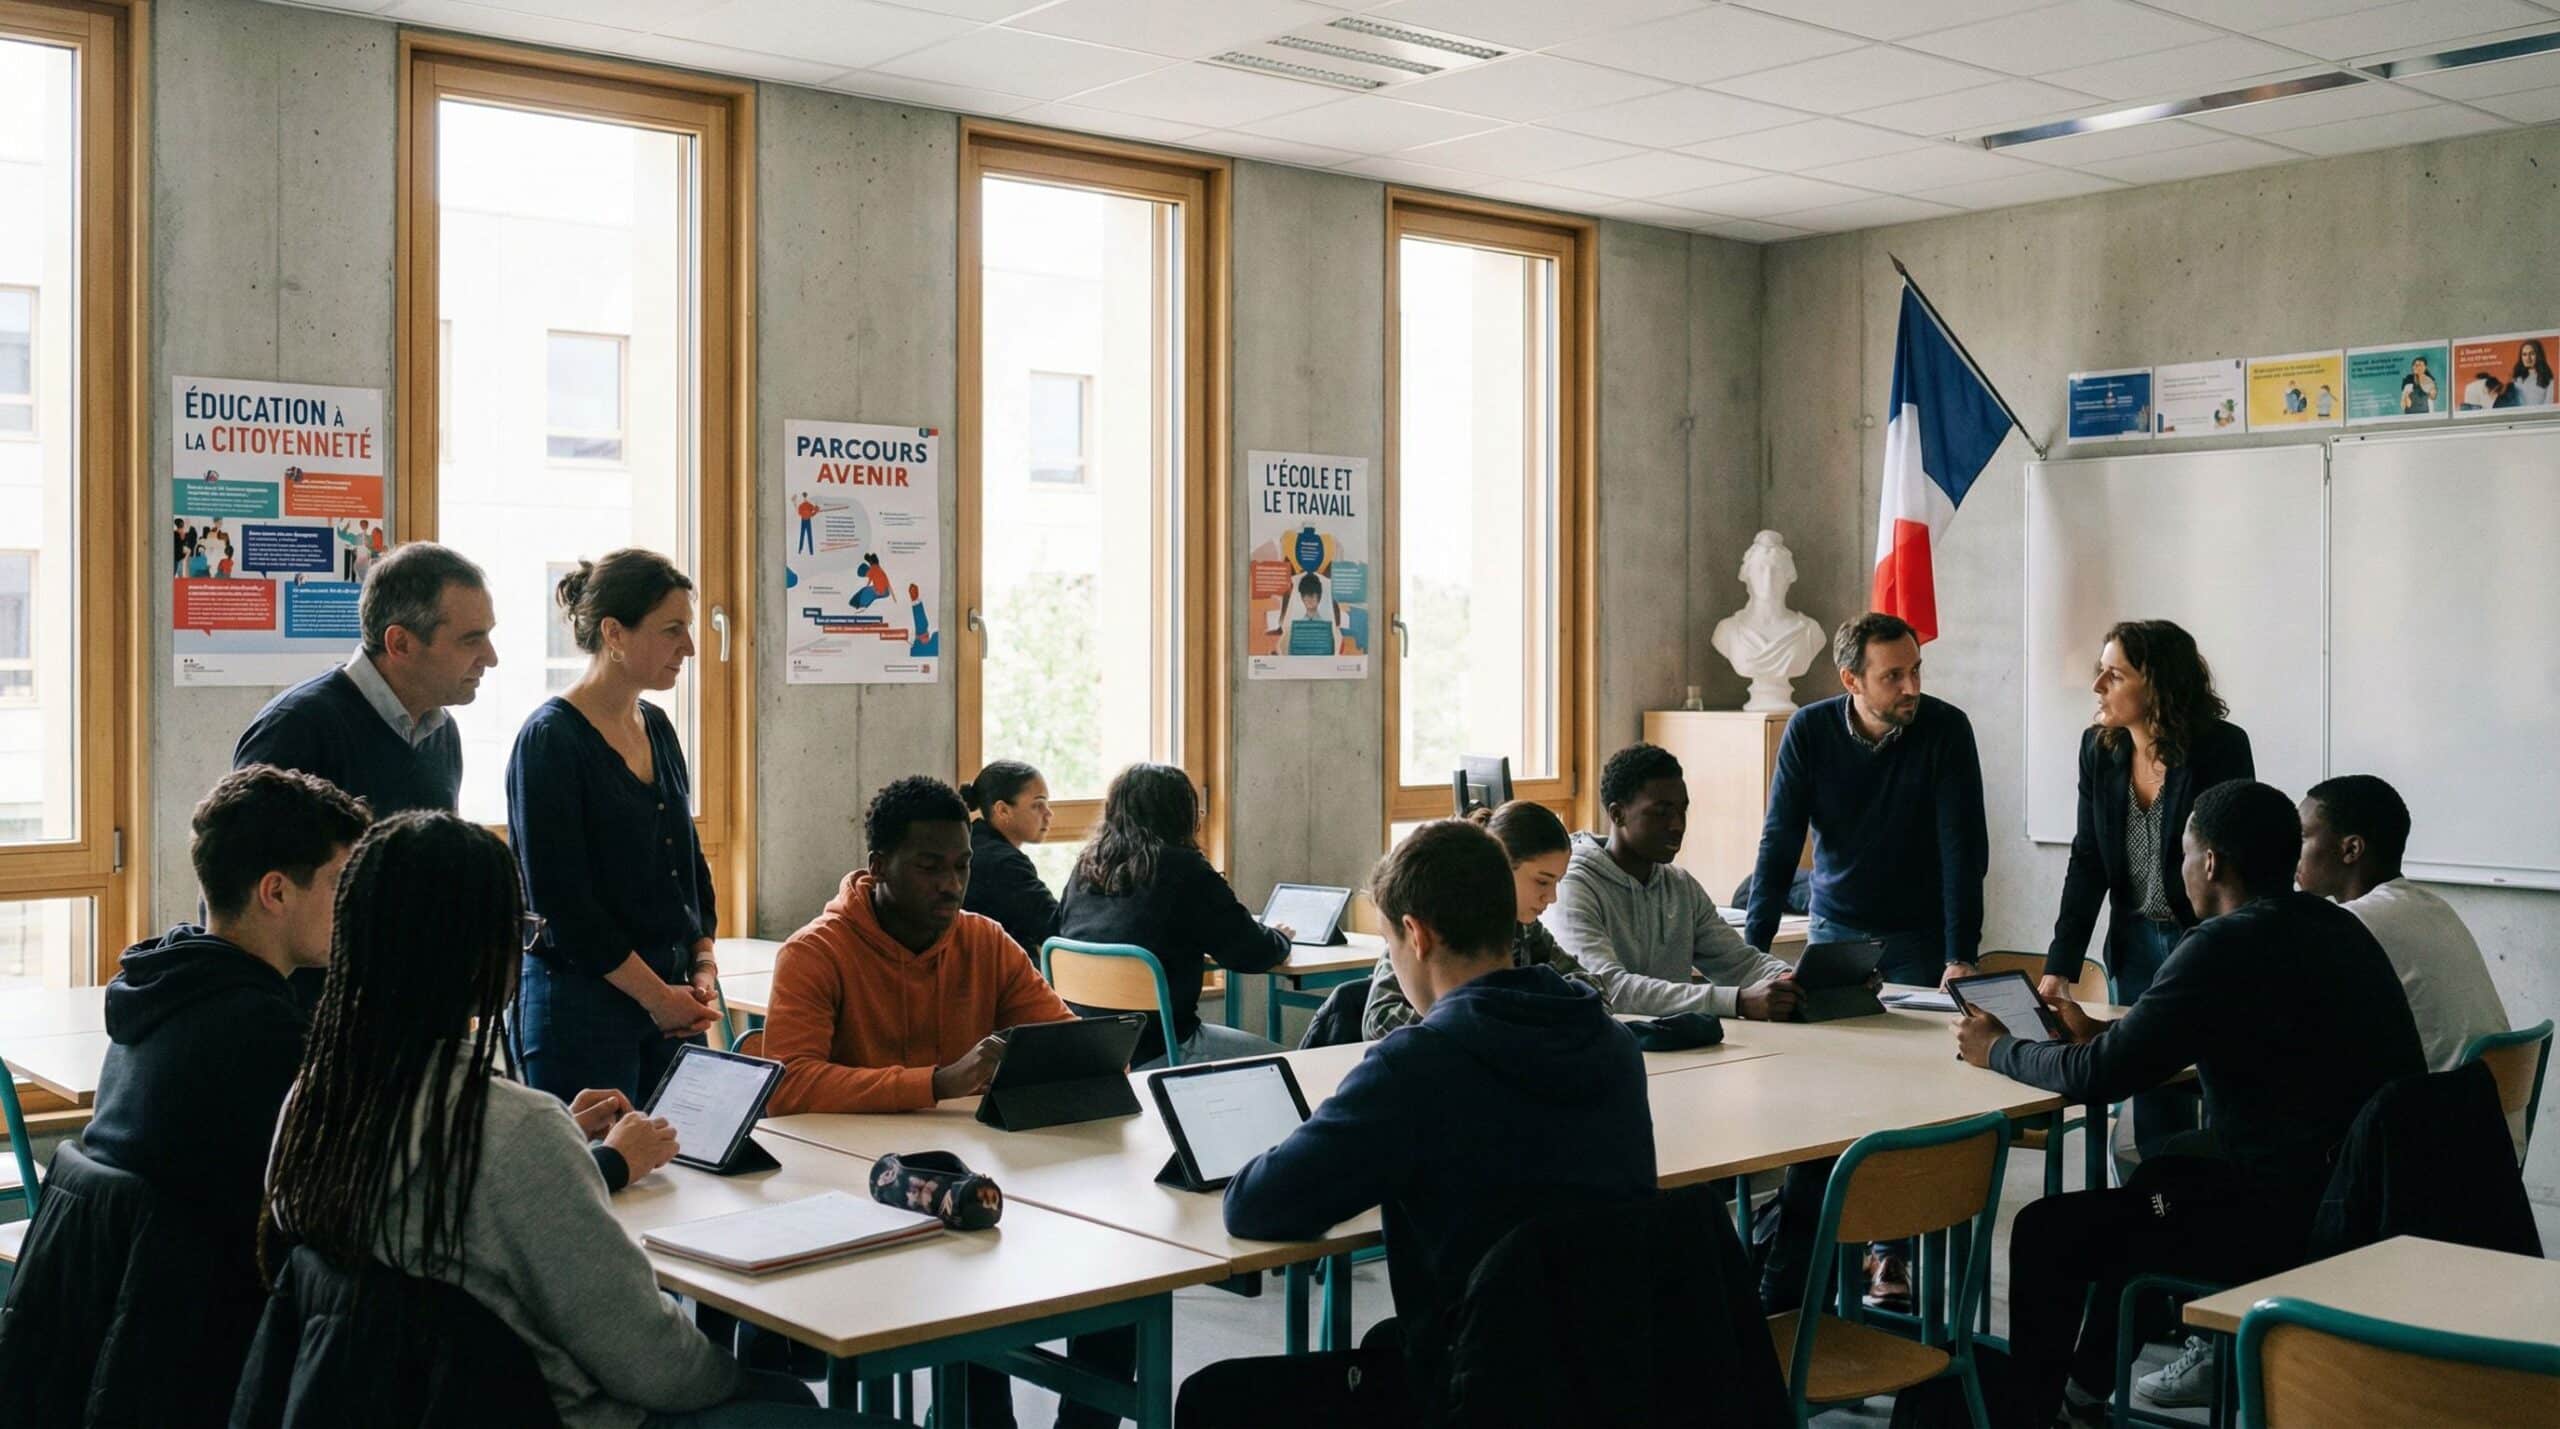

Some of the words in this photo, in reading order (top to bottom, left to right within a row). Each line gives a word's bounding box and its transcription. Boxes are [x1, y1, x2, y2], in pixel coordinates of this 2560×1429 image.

[185, 386, 326, 426] ÉDUCATION
[333, 406, 344, 427] À
[185, 432, 206, 451] LA
[212, 426, 372, 459] CITOYENNETÉ
[796, 436, 928, 464] PARCOURS
[817, 463, 910, 487] AVENIR
[1266, 459, 1329, 489] L'ÉCOLE
[1335, 469, 1353, 491] ET
[1264, 490, 1282, 514] LE
[1287, 492, 1355, 517] TRAVAIL
